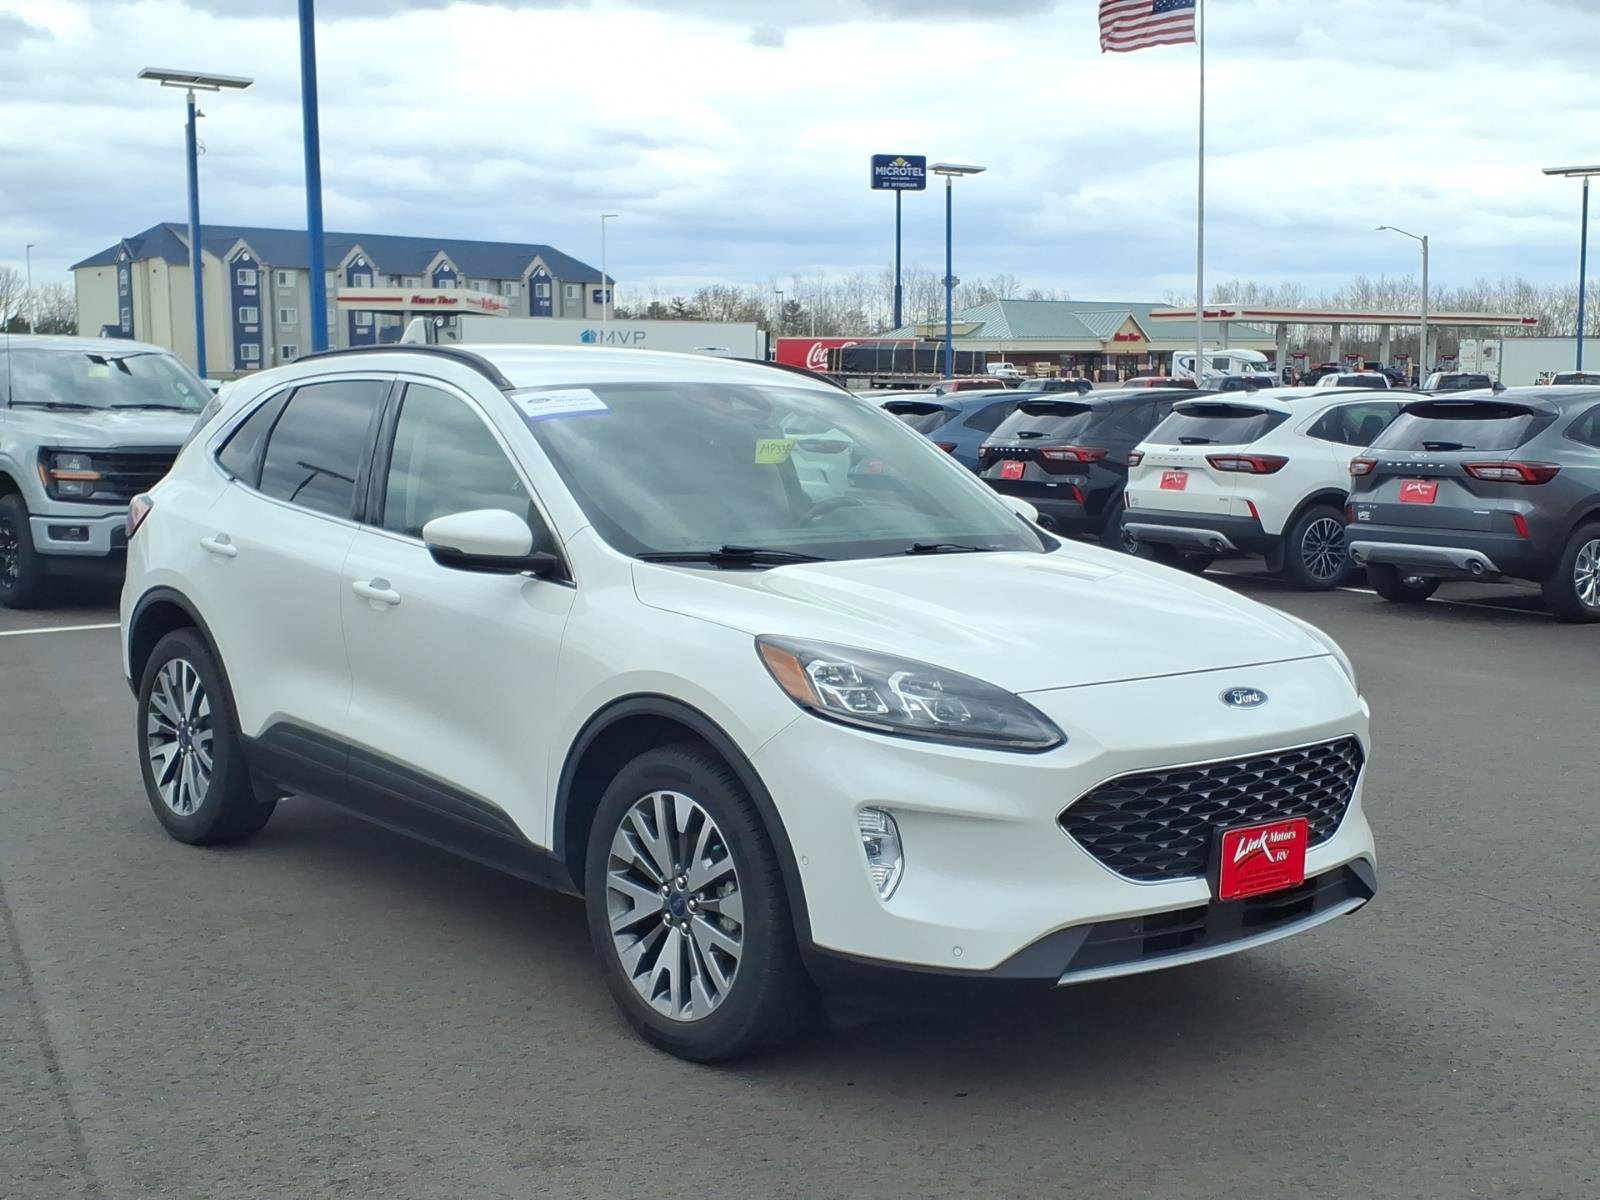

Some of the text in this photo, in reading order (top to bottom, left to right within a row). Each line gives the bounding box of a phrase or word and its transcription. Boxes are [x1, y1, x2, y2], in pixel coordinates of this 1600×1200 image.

[875, 166, 924, 177] MICROTEL
[600, 330, 646, 344] MVP
[1232, 689, 1260, 704] Ford
[1233, 830, 1297, 863] Link Motors
[1276, 849, 1290, 862] RV
